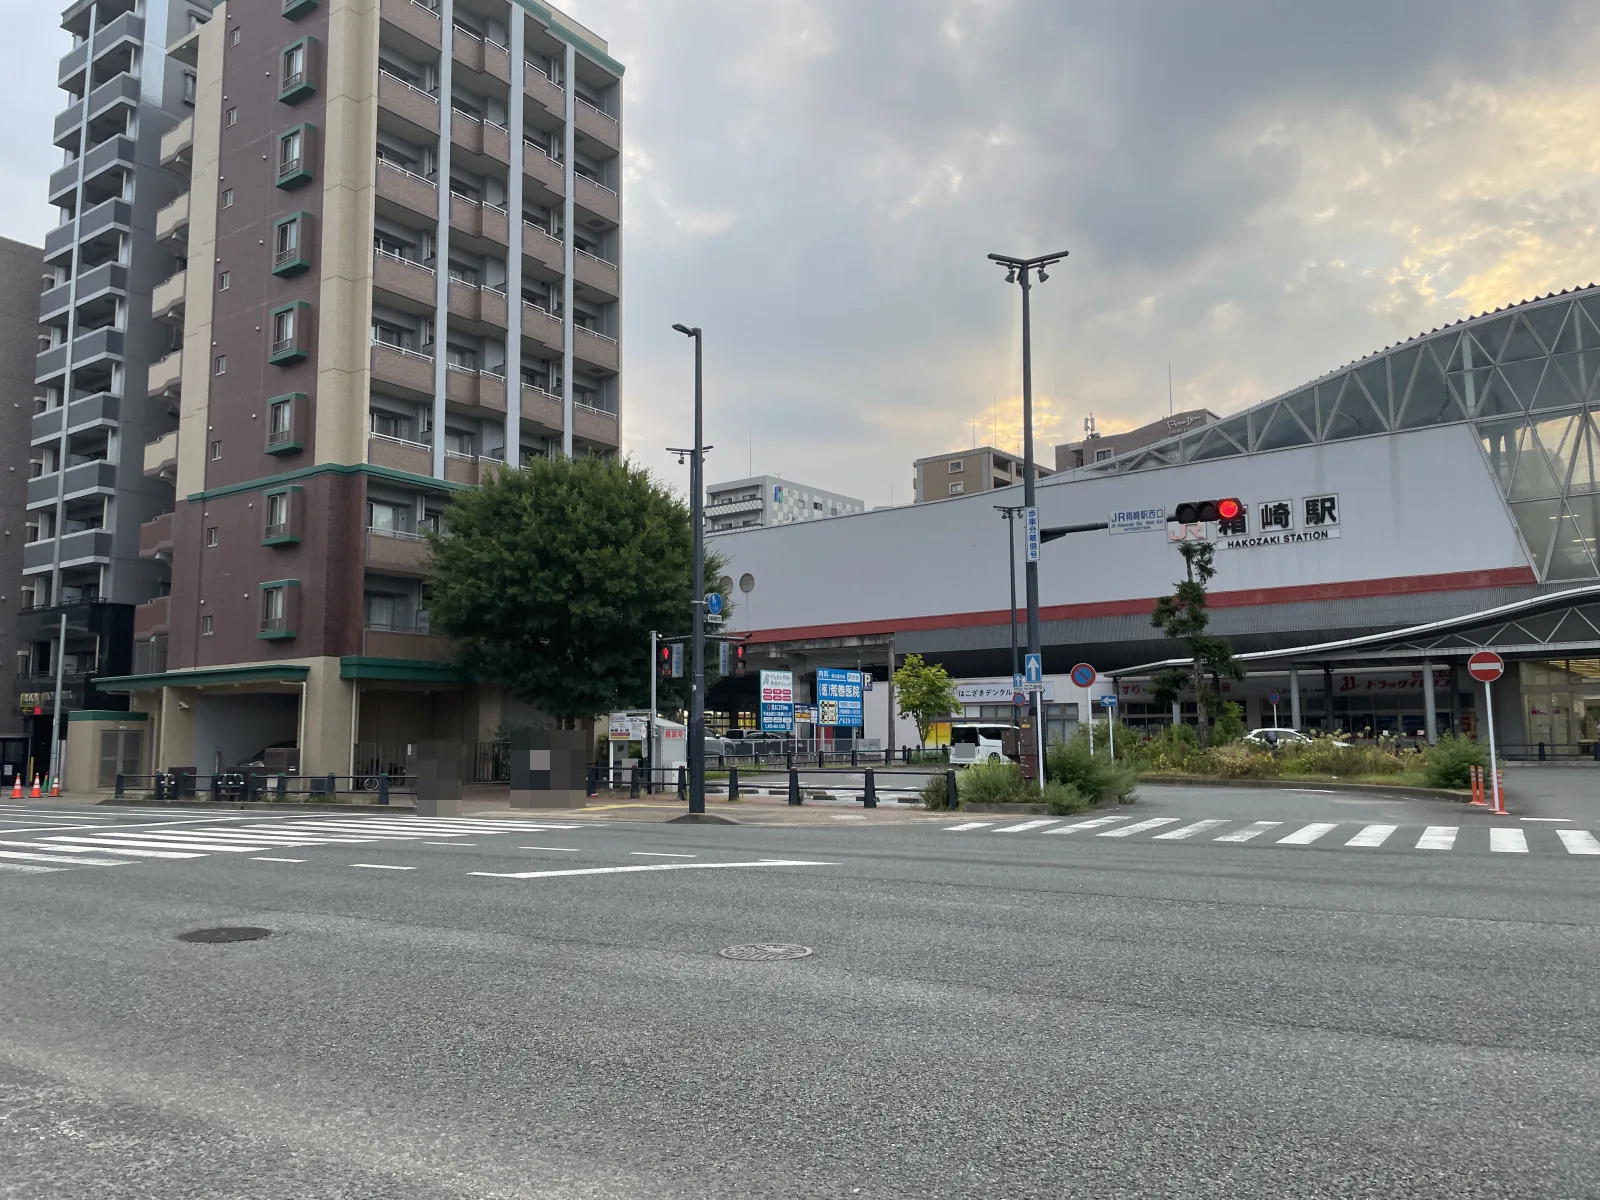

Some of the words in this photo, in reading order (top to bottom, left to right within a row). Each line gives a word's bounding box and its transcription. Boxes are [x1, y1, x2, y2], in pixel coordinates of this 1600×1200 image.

[1110, 509, 1164, 523] JR箱崎駅西口
[1028, 509, 1037, 558] 歩車分離信号
[1227, 534, 1280, 549] HAKOZAKI
[1284, 530, 1328, 543] STATION
[958, 689, 1045, 697] はこざきデンタル
